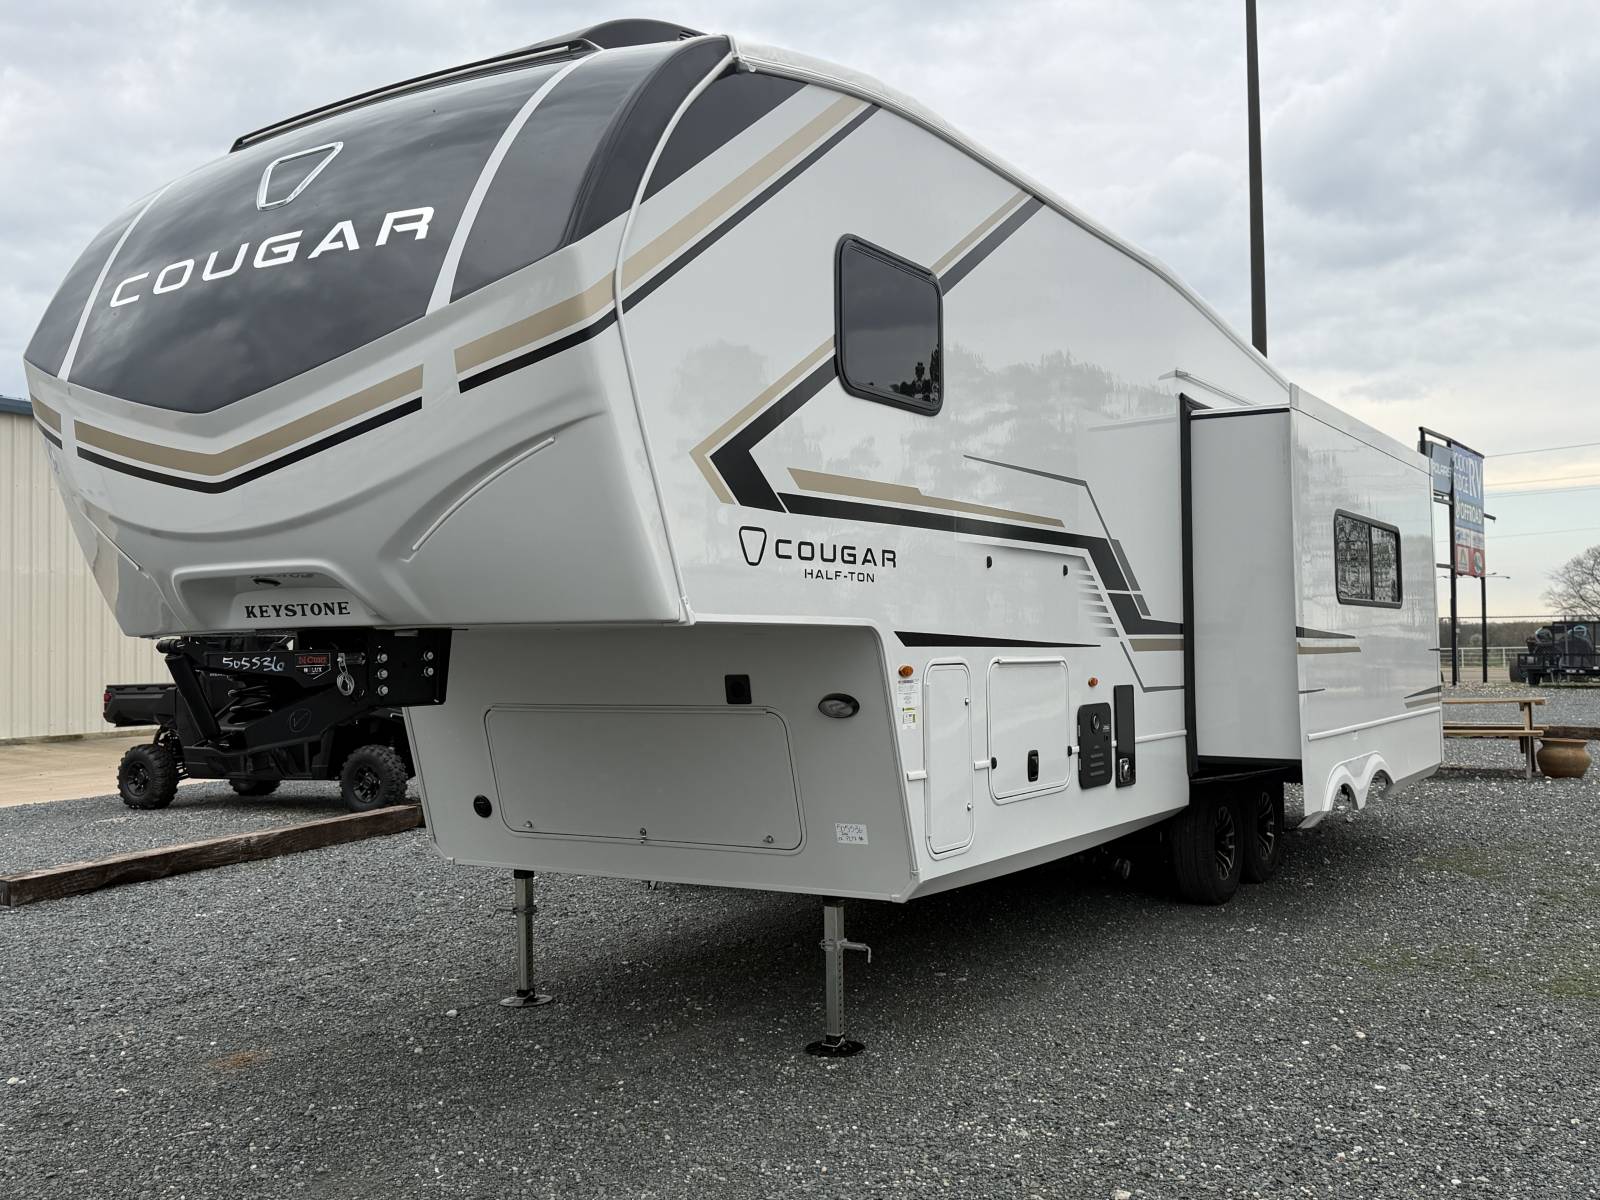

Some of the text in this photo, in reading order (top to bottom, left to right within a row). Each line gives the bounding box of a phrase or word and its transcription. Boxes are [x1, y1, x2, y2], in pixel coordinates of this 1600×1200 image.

[110, 206, 434, 307] COUGAR
[775, 539, 897, 568] COUGAR
[804, 568, 875, 583] HALF-TON
[244, 601, 351, 619] KEYSTONE
[222, 656, 285, 672] 505536
